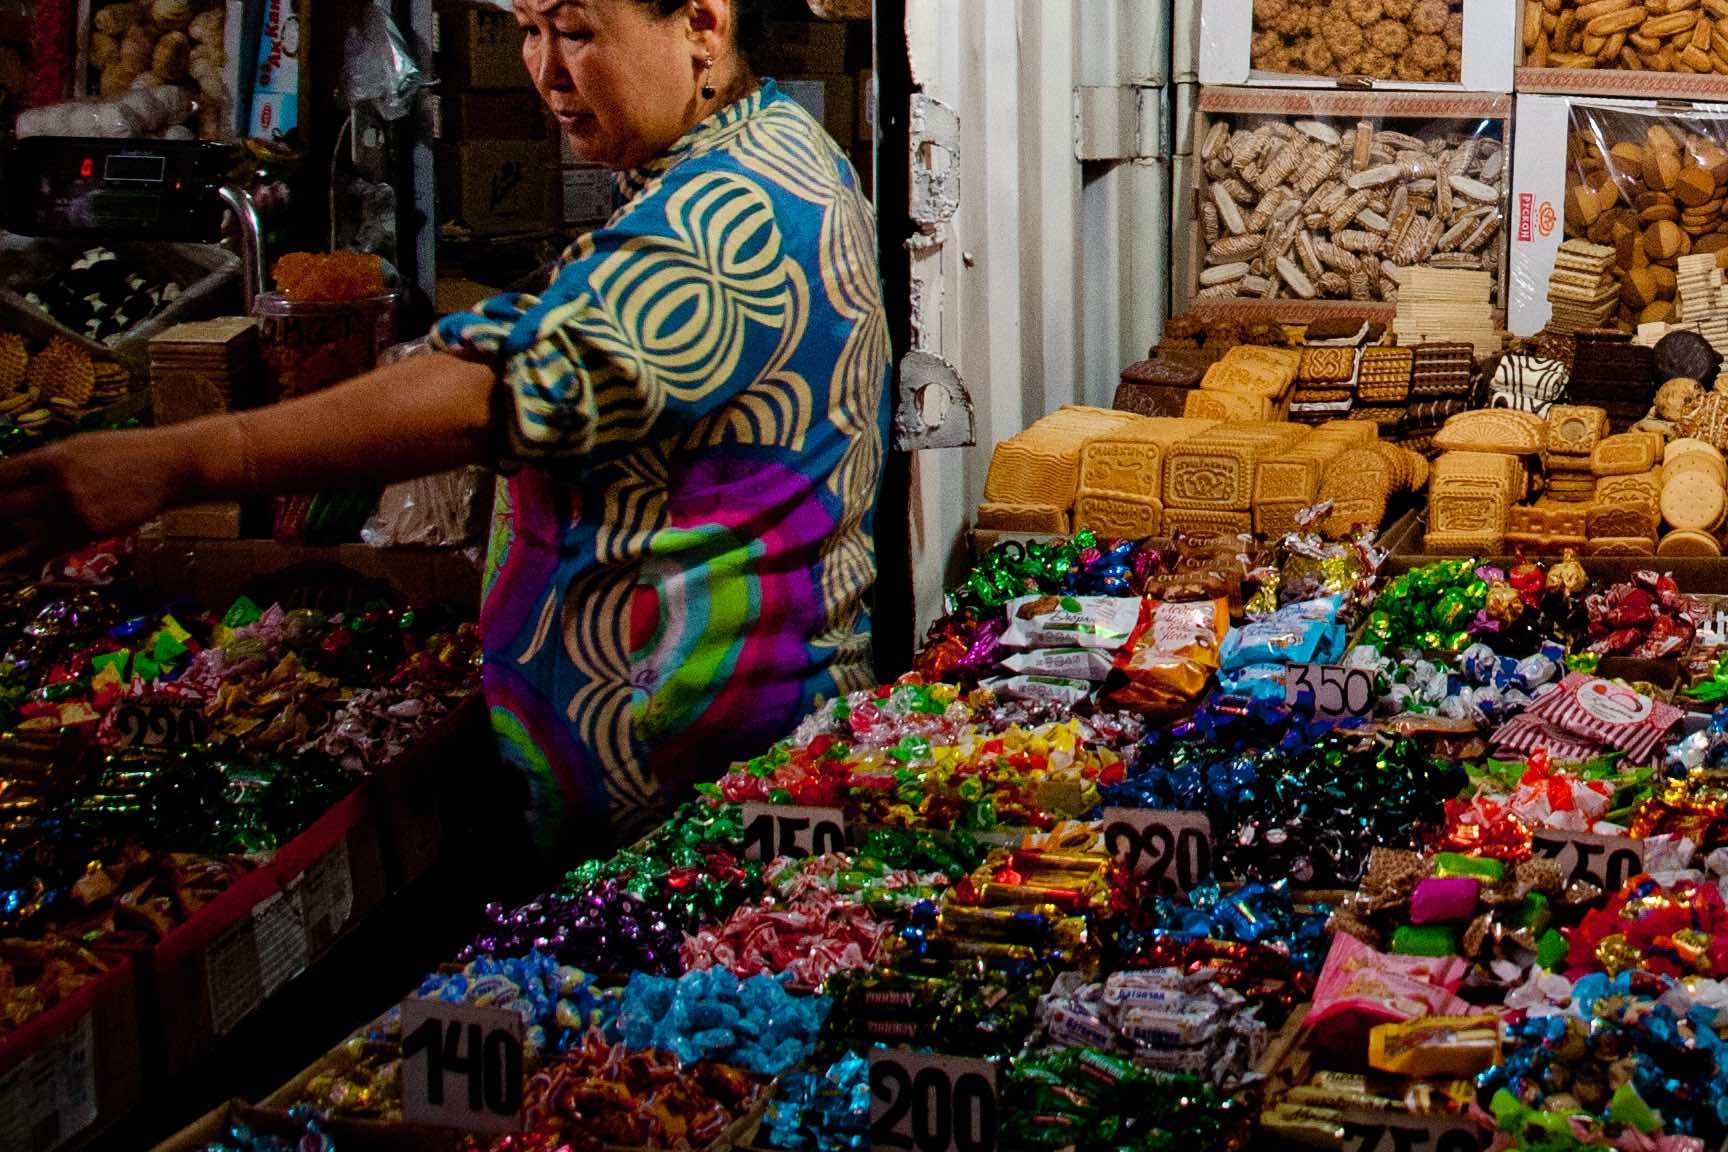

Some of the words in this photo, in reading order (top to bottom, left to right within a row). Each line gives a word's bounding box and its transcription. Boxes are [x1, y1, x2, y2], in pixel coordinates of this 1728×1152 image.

[1520, 195, 1531, 239] РУСКОН
[1286, 664, 1373, 719] 350
[743, 814, 844, 861] 150
[1103, 821, 1209, 897] 220
[403, 1017, 523, 1117] 140
[869, 1059, 996, 1152] 200
